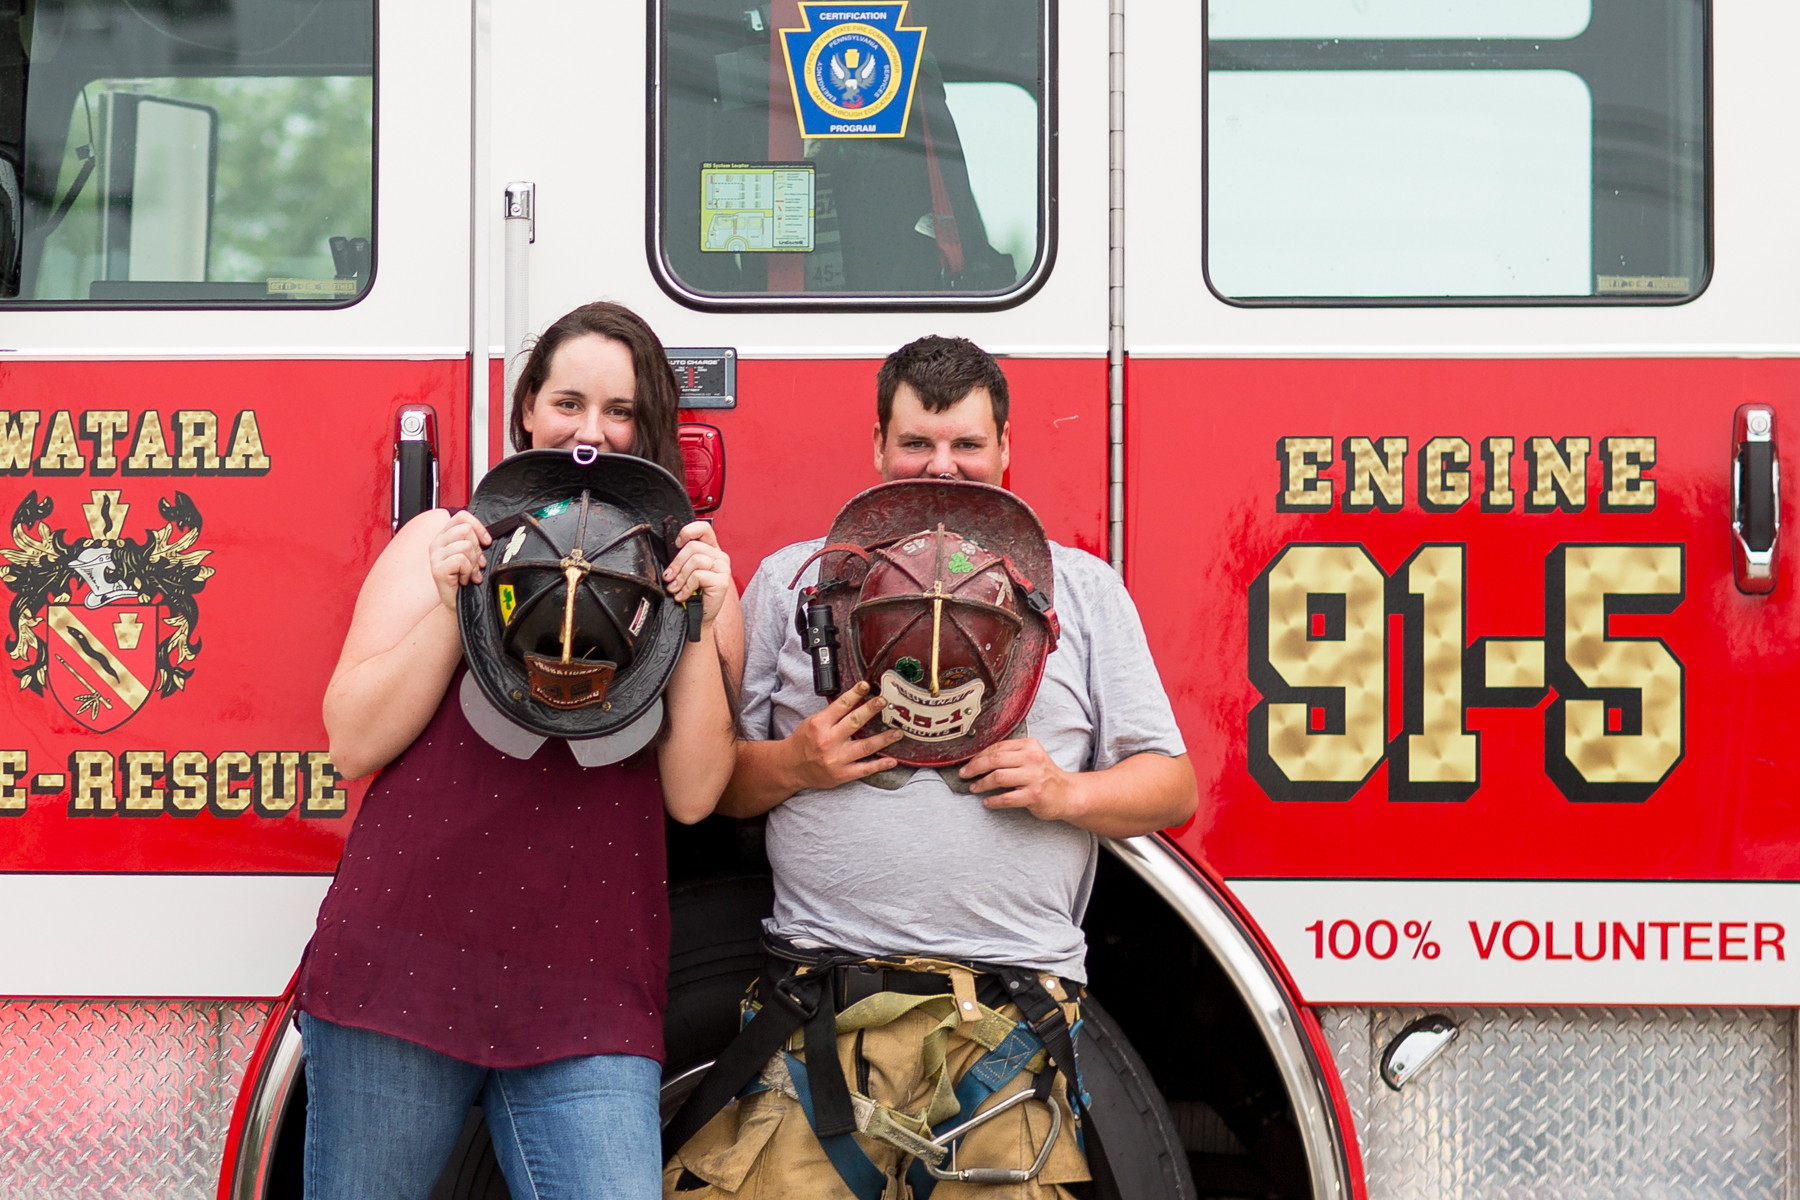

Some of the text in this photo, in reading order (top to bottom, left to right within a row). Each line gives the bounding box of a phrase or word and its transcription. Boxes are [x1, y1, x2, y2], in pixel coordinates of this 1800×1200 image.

[819, 12, 887, 20] CERTIFICATION
[832, 26, 851, 35] STATE
[852, 25, 866, 33] FIRE
[828, 34, 879, 51] PENNSYLVANIA
[816, 61, 838, 103] EMERGENCY
[873, 64, 890, 99] SERVICES
[864, 89, 894, 115] EDUCATION
[830, 124, 877, 132] PROGRAM
[0, 410, 272, 477] WATARA
[1276, 436, 1657, 513] ENGINE
[1247, 542, 1686, 803] 91-5
[894, 705, 963, 729] 45-1
[0, 750, 347, 819] E-RESCUE
[1304, 919, 1786, 962] 100% VOLUNTEER
